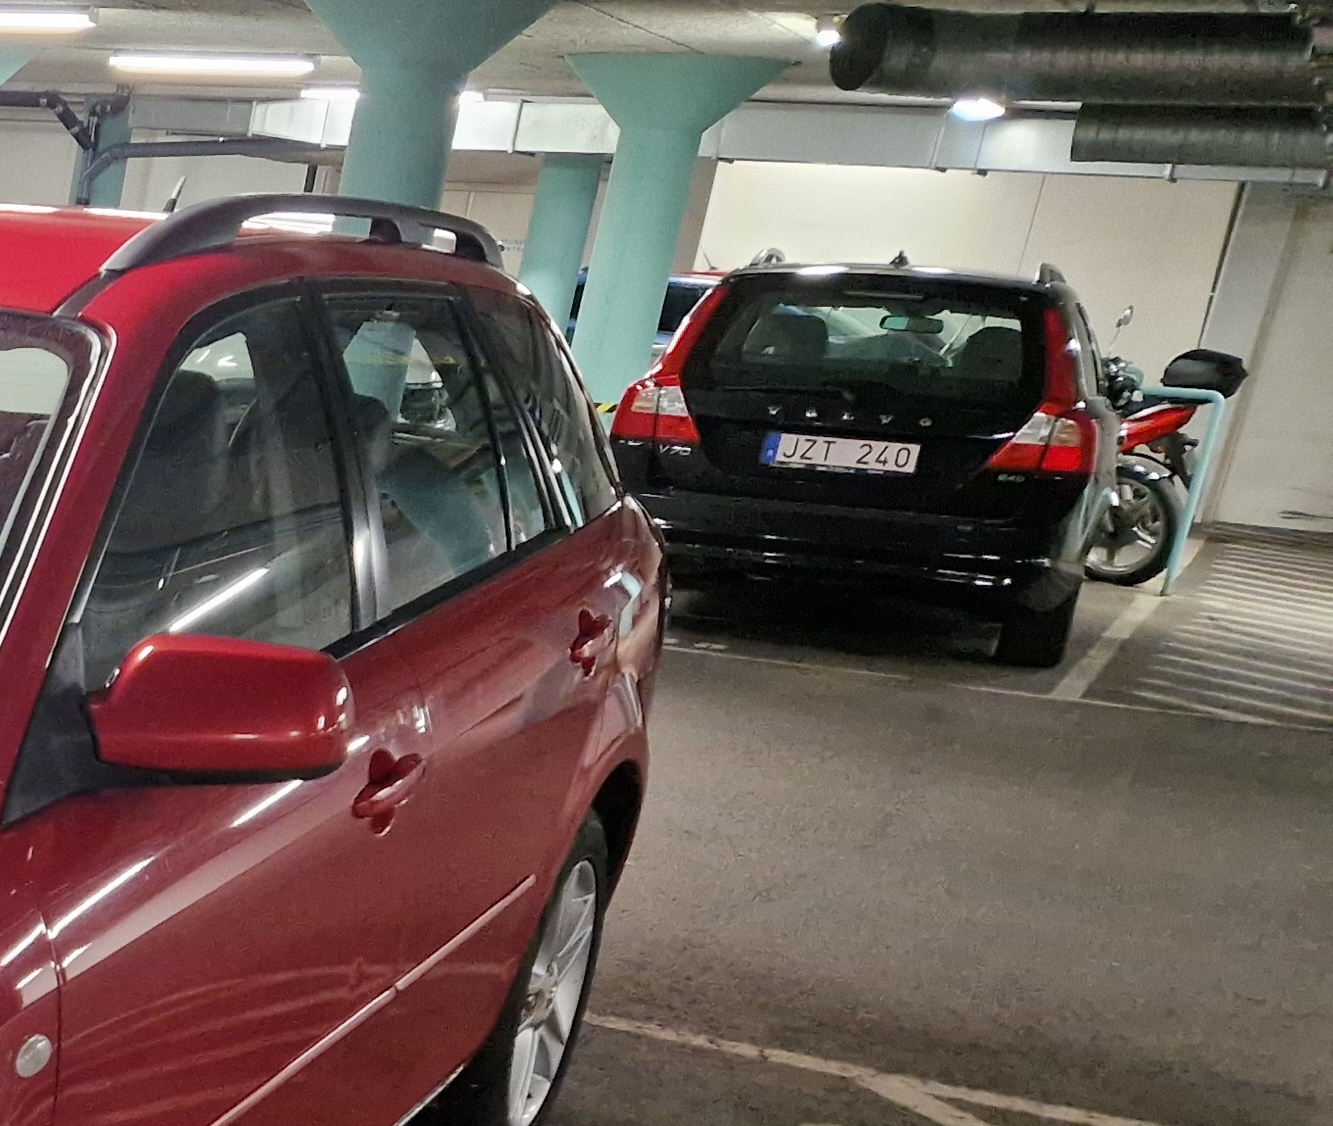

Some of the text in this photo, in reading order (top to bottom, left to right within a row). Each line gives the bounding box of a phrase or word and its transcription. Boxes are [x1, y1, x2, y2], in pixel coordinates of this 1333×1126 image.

[767, 405, 934, 427] VOLVO
[658, 444, 692, 456] V70
[782, 438, 912, 469] JZT 240
